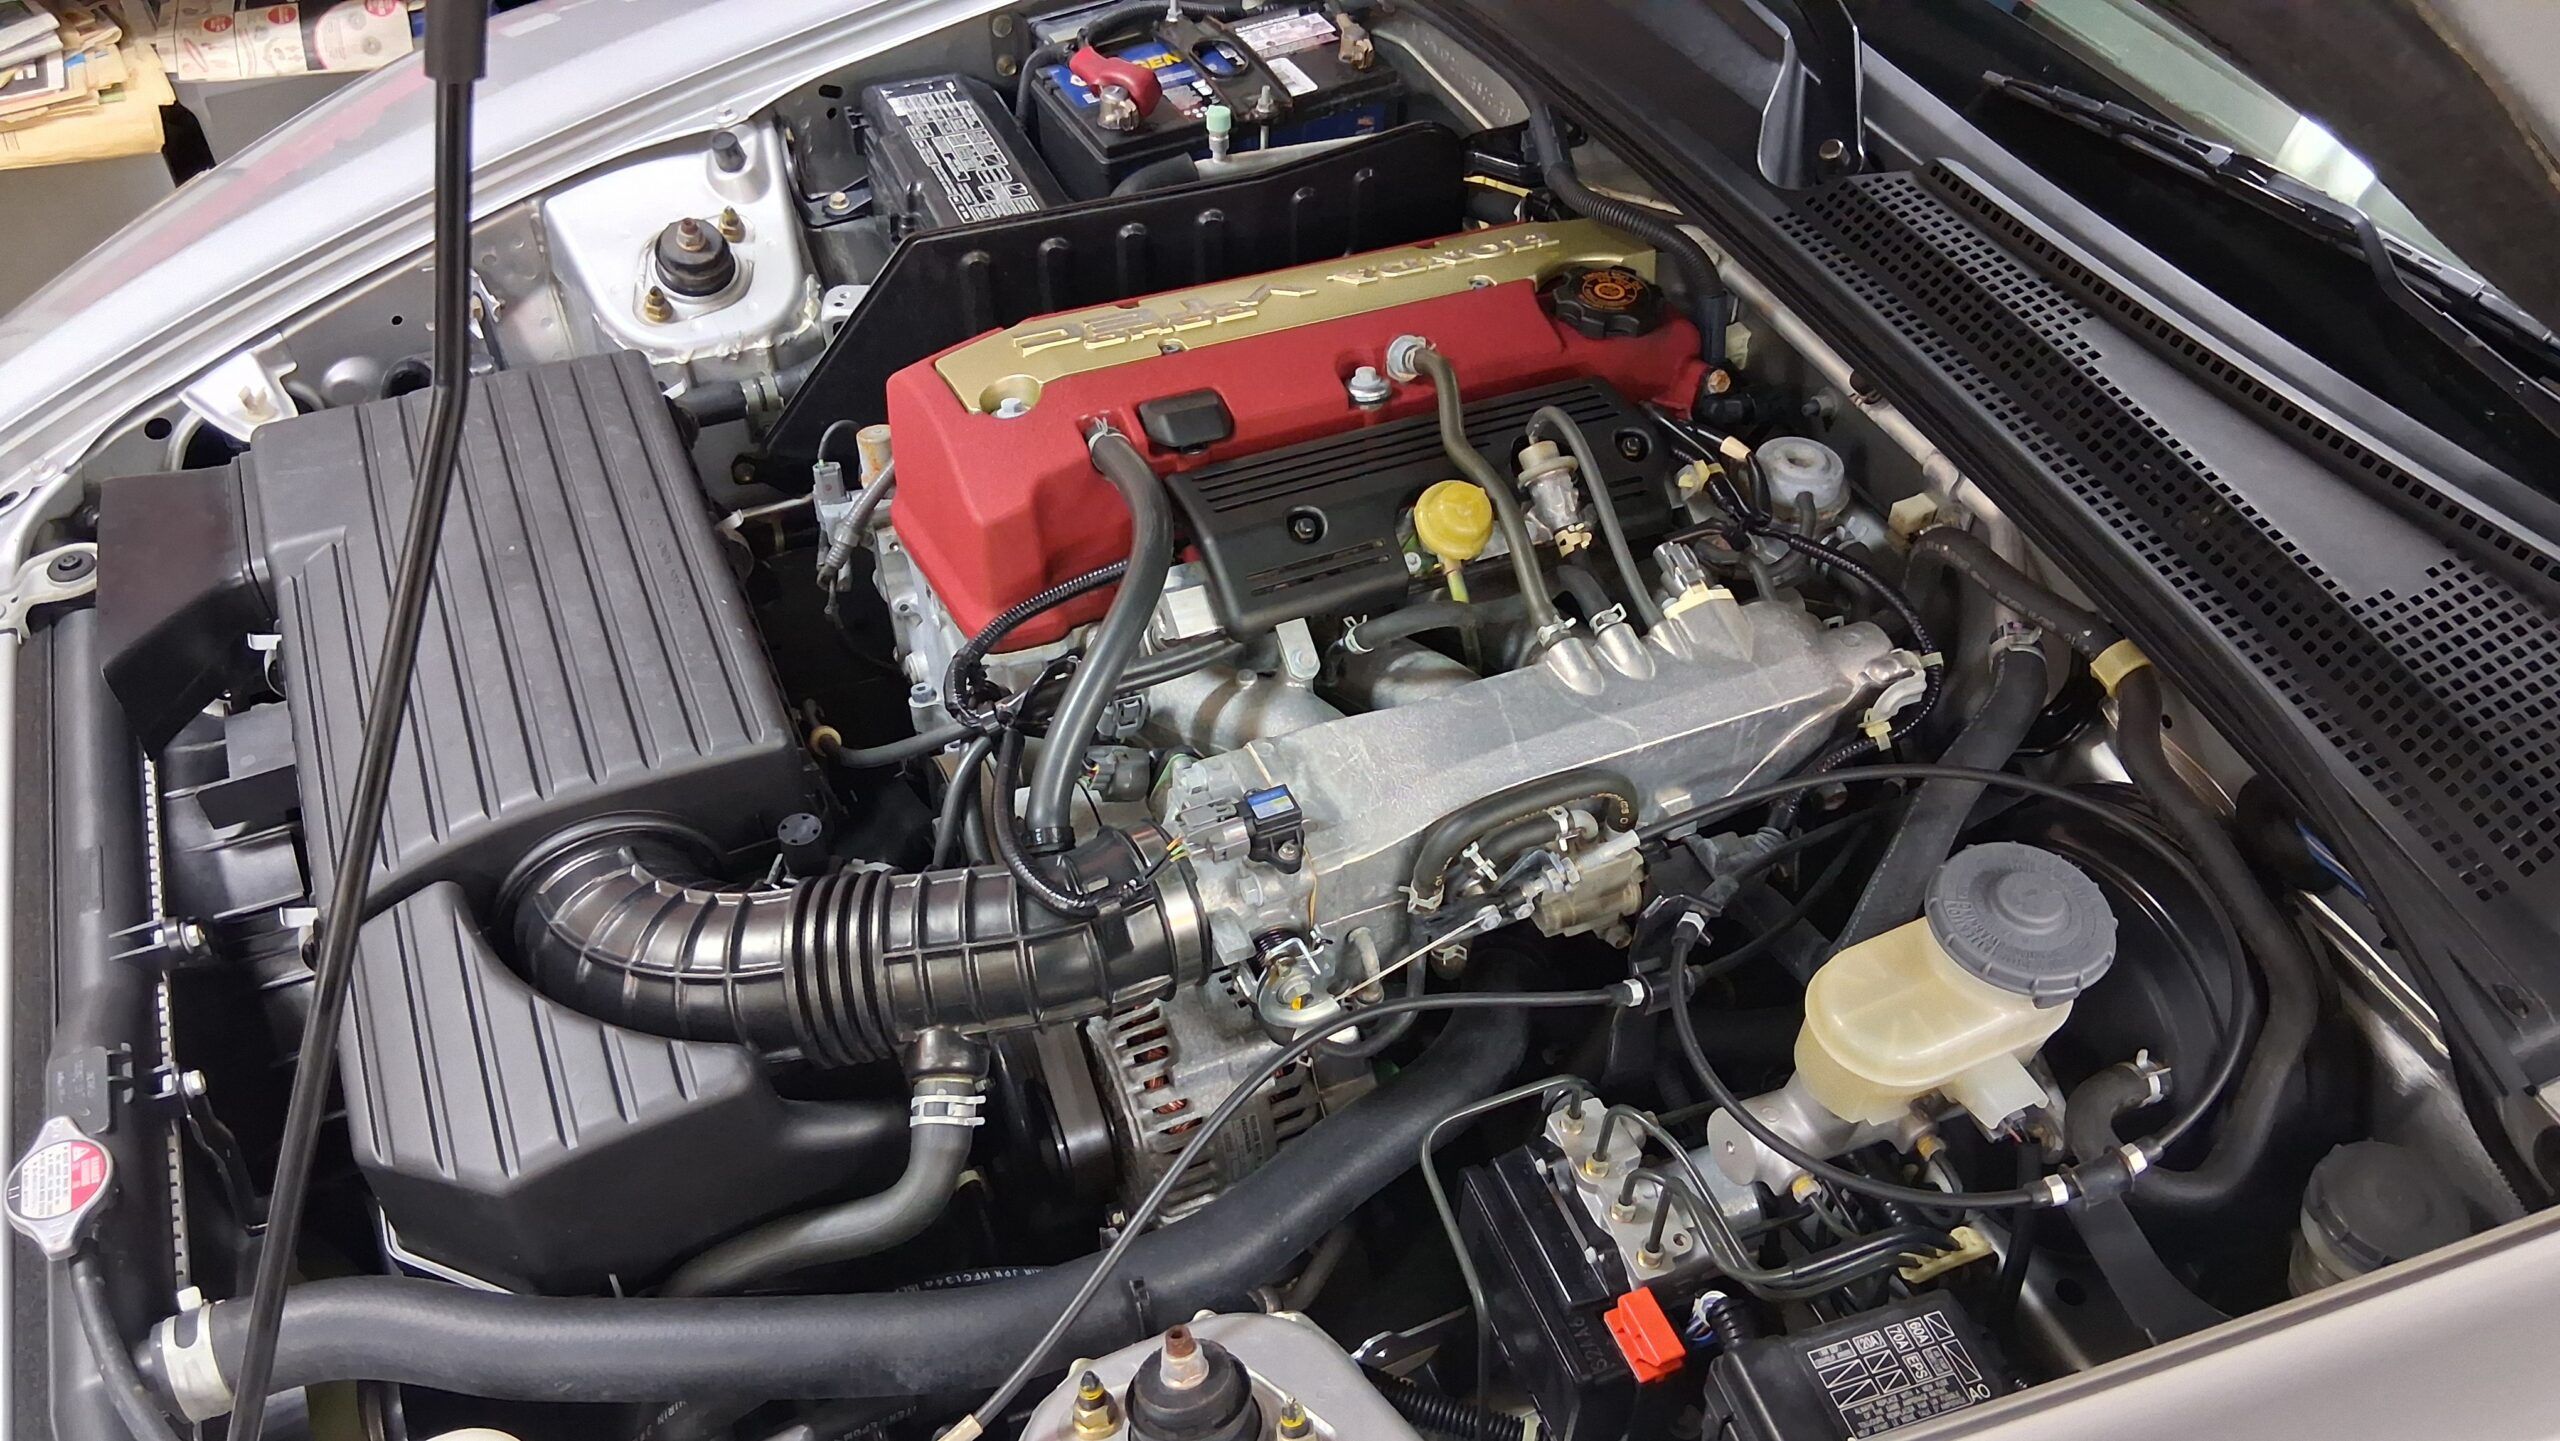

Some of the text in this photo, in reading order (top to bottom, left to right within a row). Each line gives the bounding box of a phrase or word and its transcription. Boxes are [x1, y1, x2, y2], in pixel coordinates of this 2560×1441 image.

[1888, 1327, 1910, 1349] 70A
[1908, 1321, 1930, 1344] 60A
[1906, 1355, 1929, 1379] EPS
